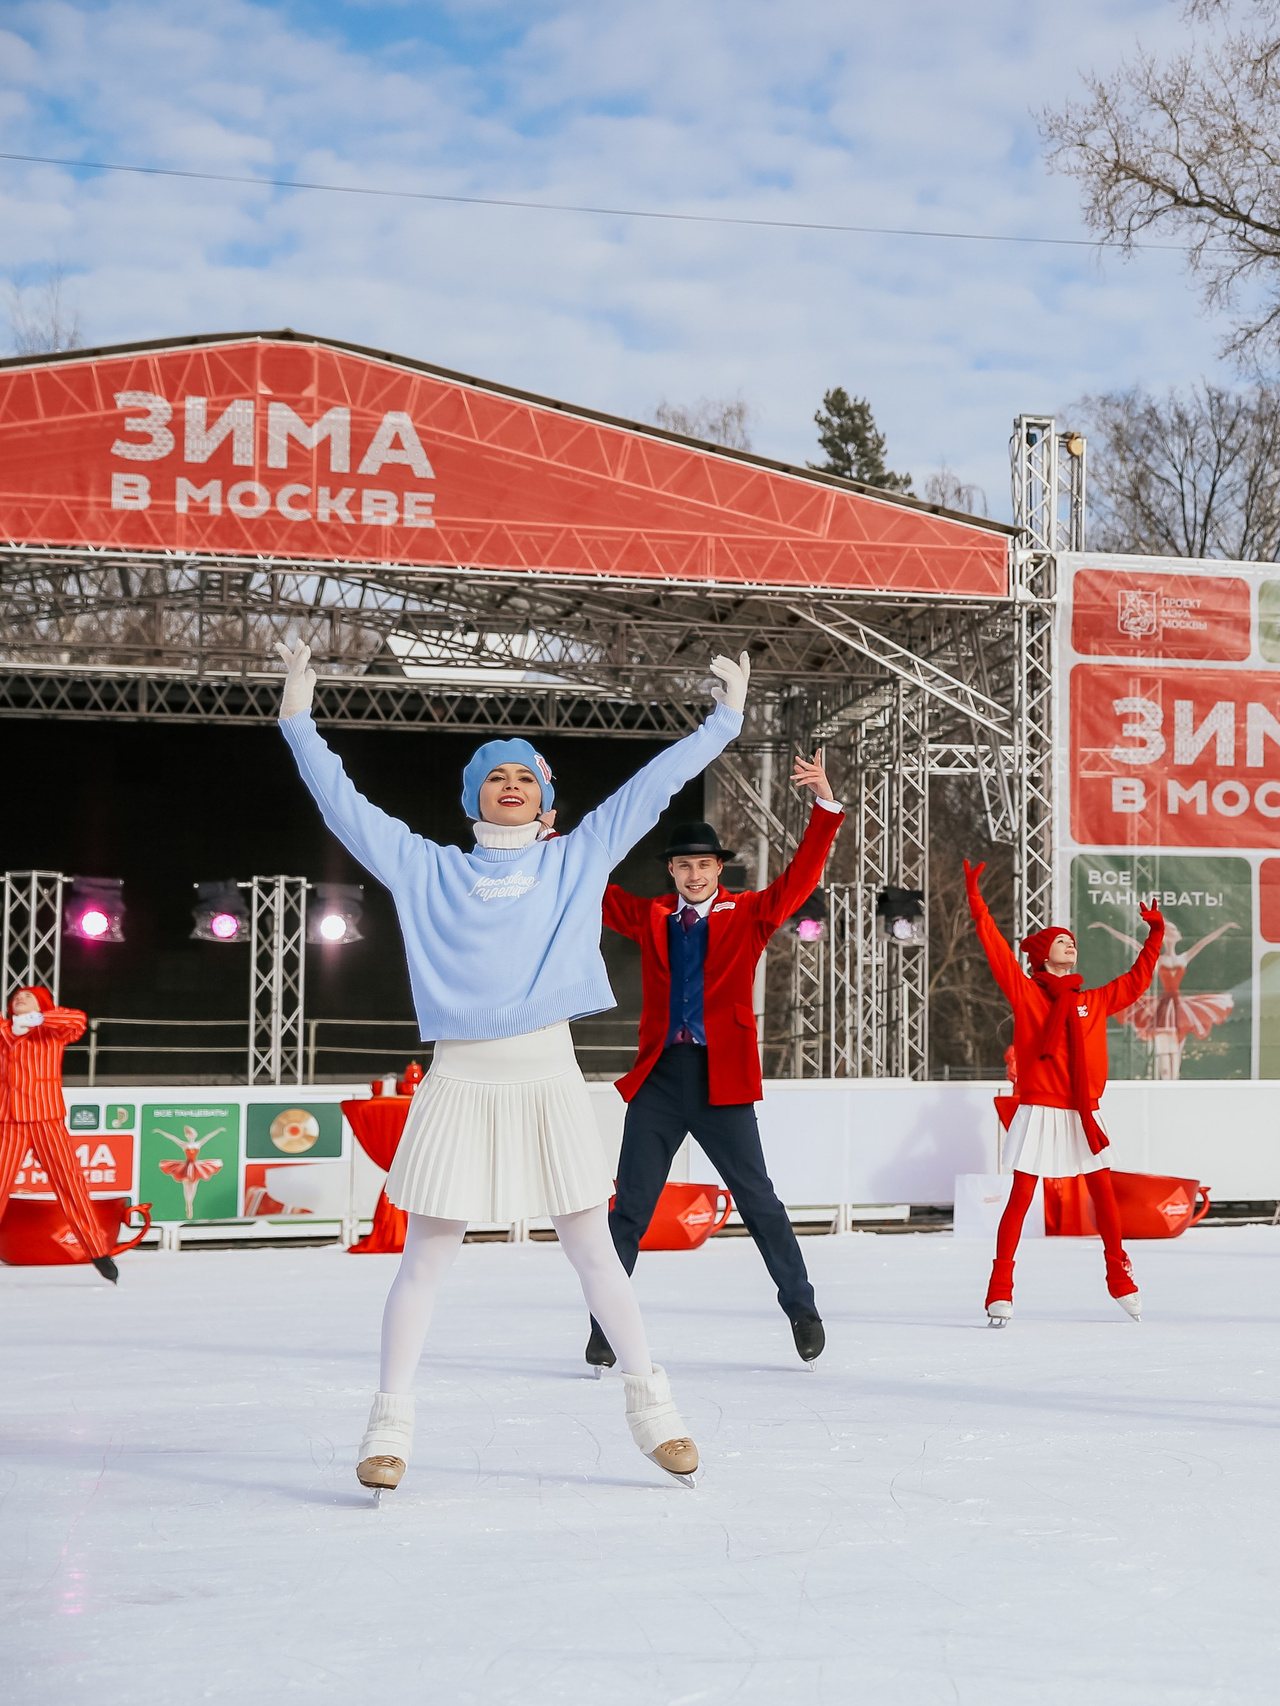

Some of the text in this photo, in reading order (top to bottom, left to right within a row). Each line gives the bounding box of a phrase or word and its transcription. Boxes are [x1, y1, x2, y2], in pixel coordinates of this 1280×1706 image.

[110, 390, 436, 480] ЗИМА
[110, 473, 436, 529] В МОСКВЕ
[1160, 597, 1203, 608] ПРОЕКТ
[1160, 608, 1191, 619] МЭРА
[1160, 619, 1208, 630] МОСКВЫ
[1111, 778, 1148, 813] В
[1088, 869, 1132, 886] ВСЕ
[1087, 889, 1224, 907] ТАНЦЕВАТЬ!
